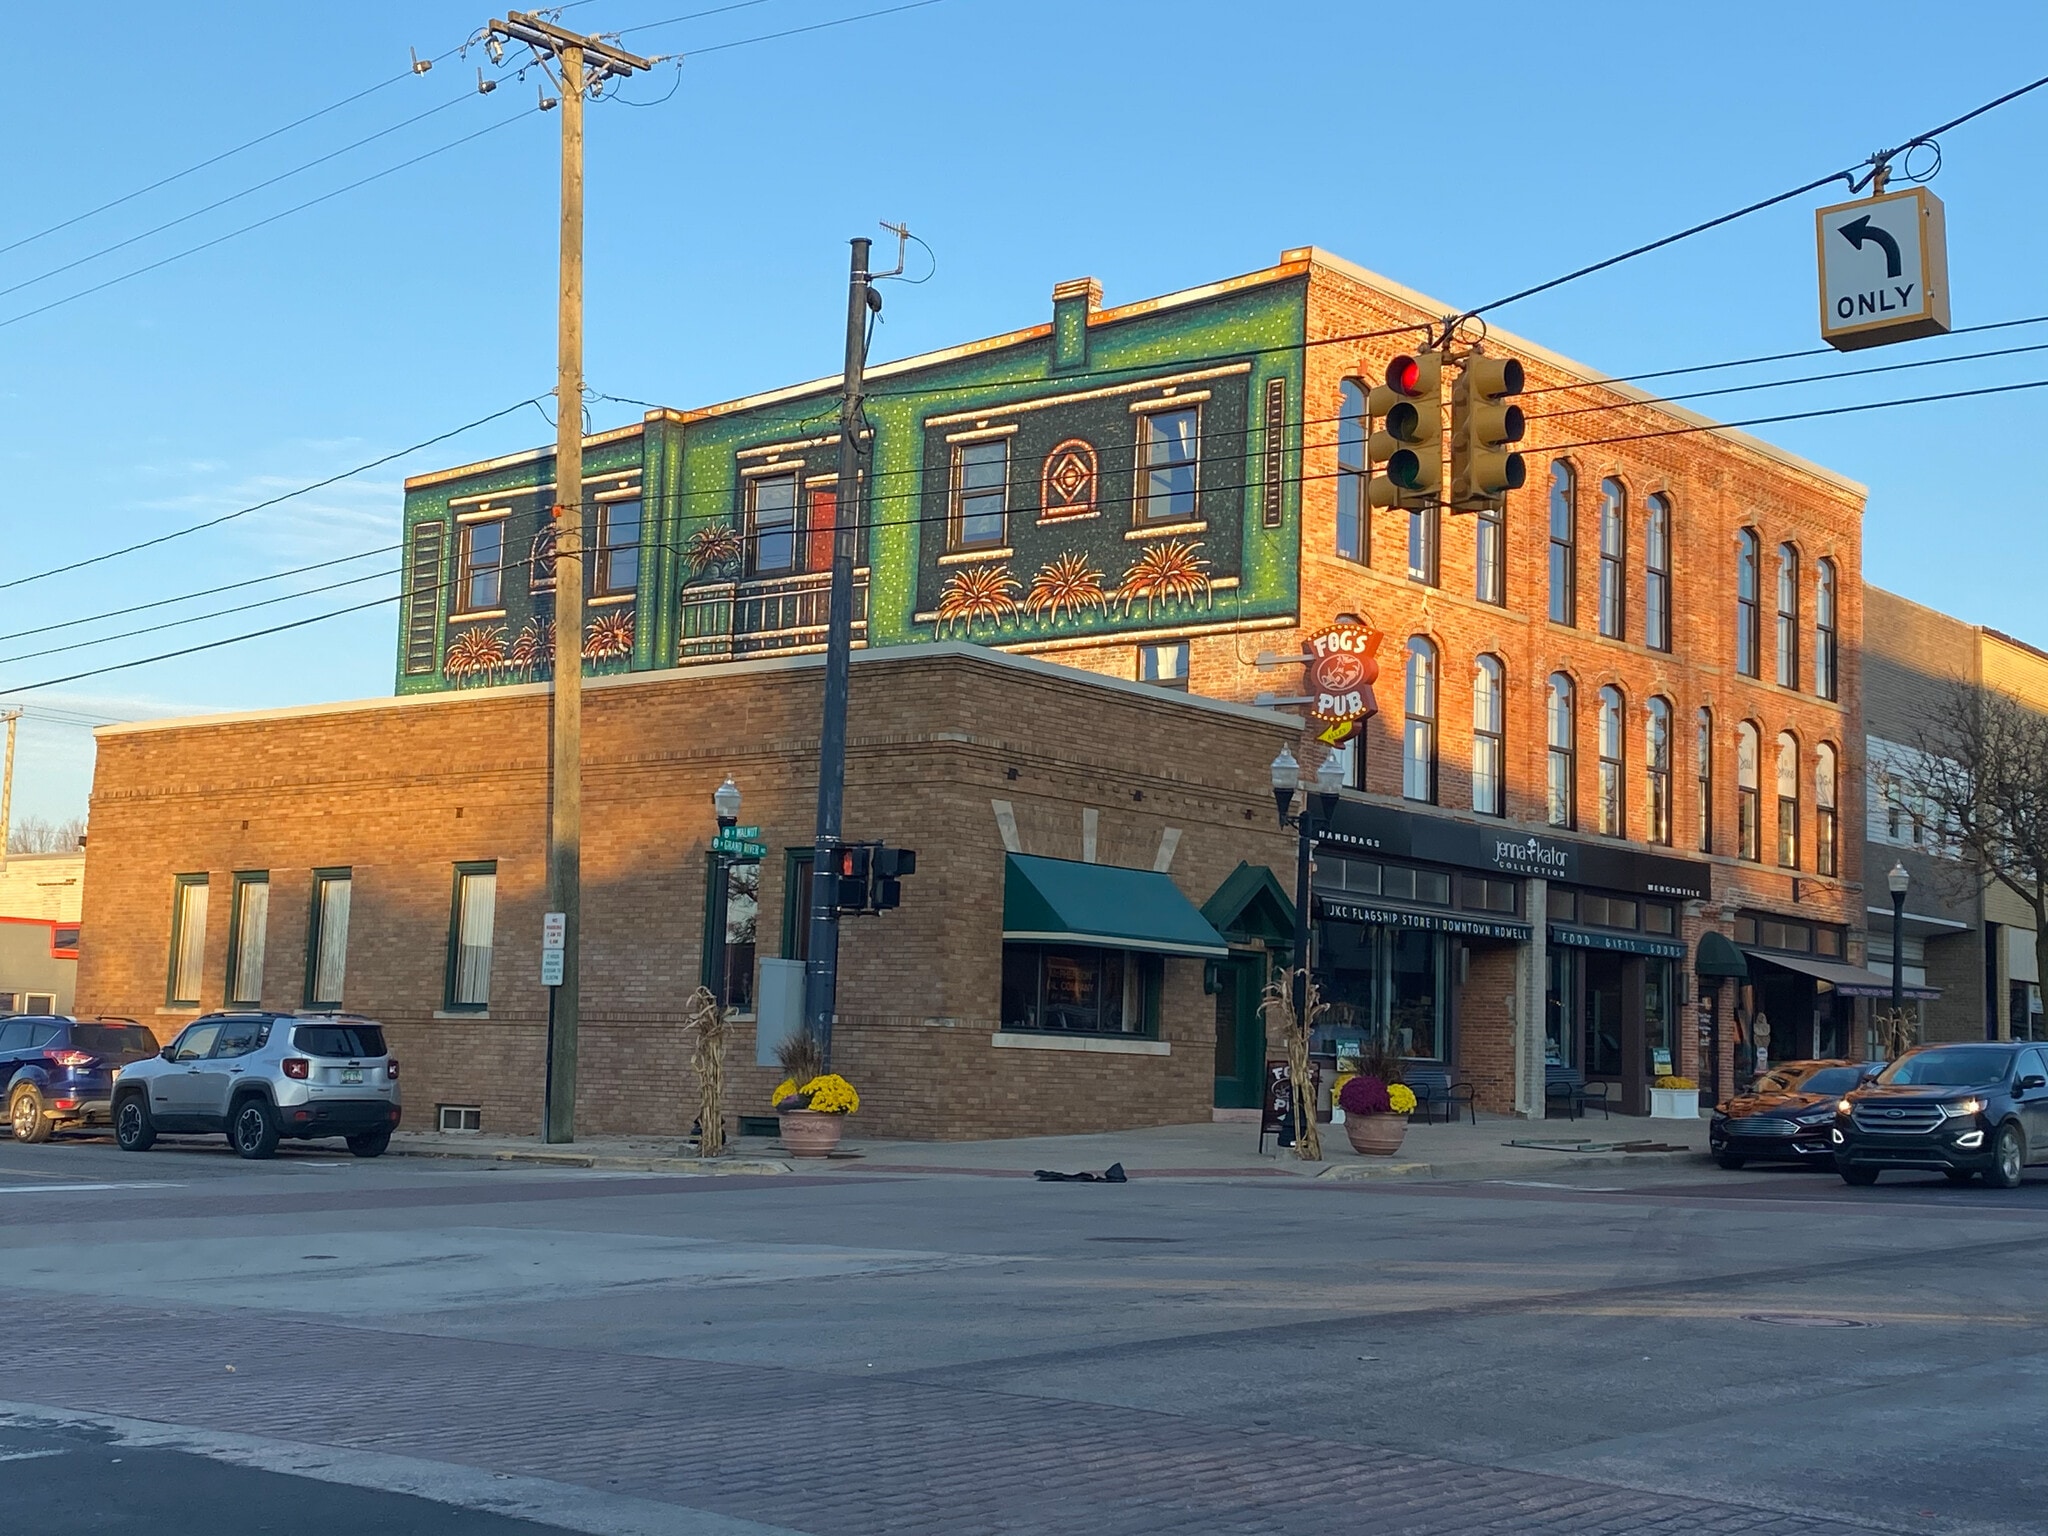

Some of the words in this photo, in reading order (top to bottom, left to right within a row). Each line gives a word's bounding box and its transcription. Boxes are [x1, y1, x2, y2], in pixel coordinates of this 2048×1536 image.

[1837, 283, 1915, 319] ONLY
[1313, 630, 1368, 658] FOG'S
[1318, 690, 1363, 716] PUB
[736, 826, 758, 838] WALNUT
[1318, 830, 1380, 848] HANDBAGS
[724, 840, 742, 853] GRAND
[743, 842, 759, 855] RIVER
[1492, 836, 1526, 862] jenna
[1536, 841, 1569, 867] kator
[1499, 861, 1565, 877] COLLECTION
[1647, 884, 1701, 897] MERCANTILE
[1329, 904, 1348, 918] JKC
[1352, 907, 1398, 923] FLAGSHIP
[1402, 914, 1431, 929] STORE
[1442, 920, 1491, 935] DOWNTOWN
[1494, 927, 1527, 940] HOWELL
[1562, 932, 1591, 946] FOOD
[1605, 938, 1635, 951] GIFTS
[1650, 945, 1681, 957] GOODS
